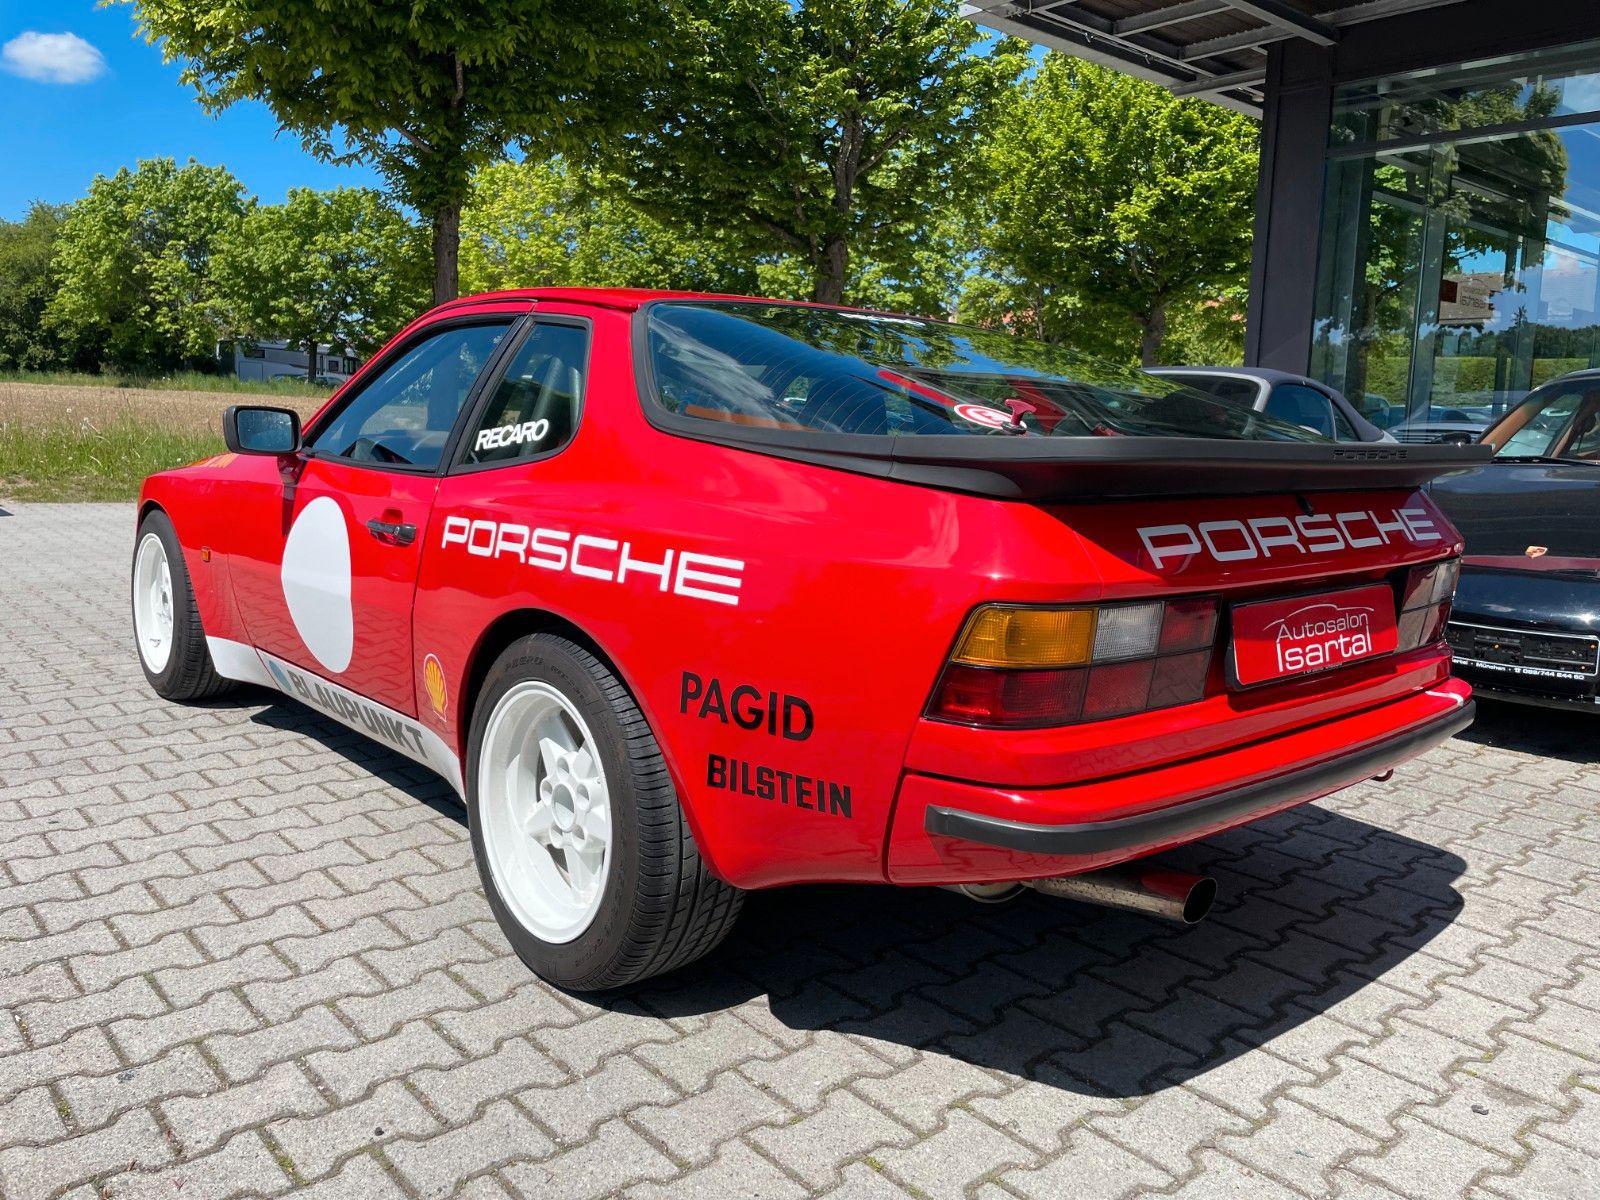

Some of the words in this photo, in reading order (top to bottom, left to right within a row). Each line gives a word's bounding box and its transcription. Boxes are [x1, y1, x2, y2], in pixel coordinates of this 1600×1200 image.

[475, 418, 549, 450] RECARO
[1333, 449, 1408, 460] PORSCHE
[441, 516, 745, 605] PORSCHE
[1136, 508, 1443, 570] PORSCHE
[1276, 612, 1368, 644] Autosalon
[1276, 625, 1372, 673] Isartal
[287, 669, 429, 759] BLAUPUNKT
[680, 671, 814, 741] PAGID
[707, 752, 852, 818] BILSTEIN
